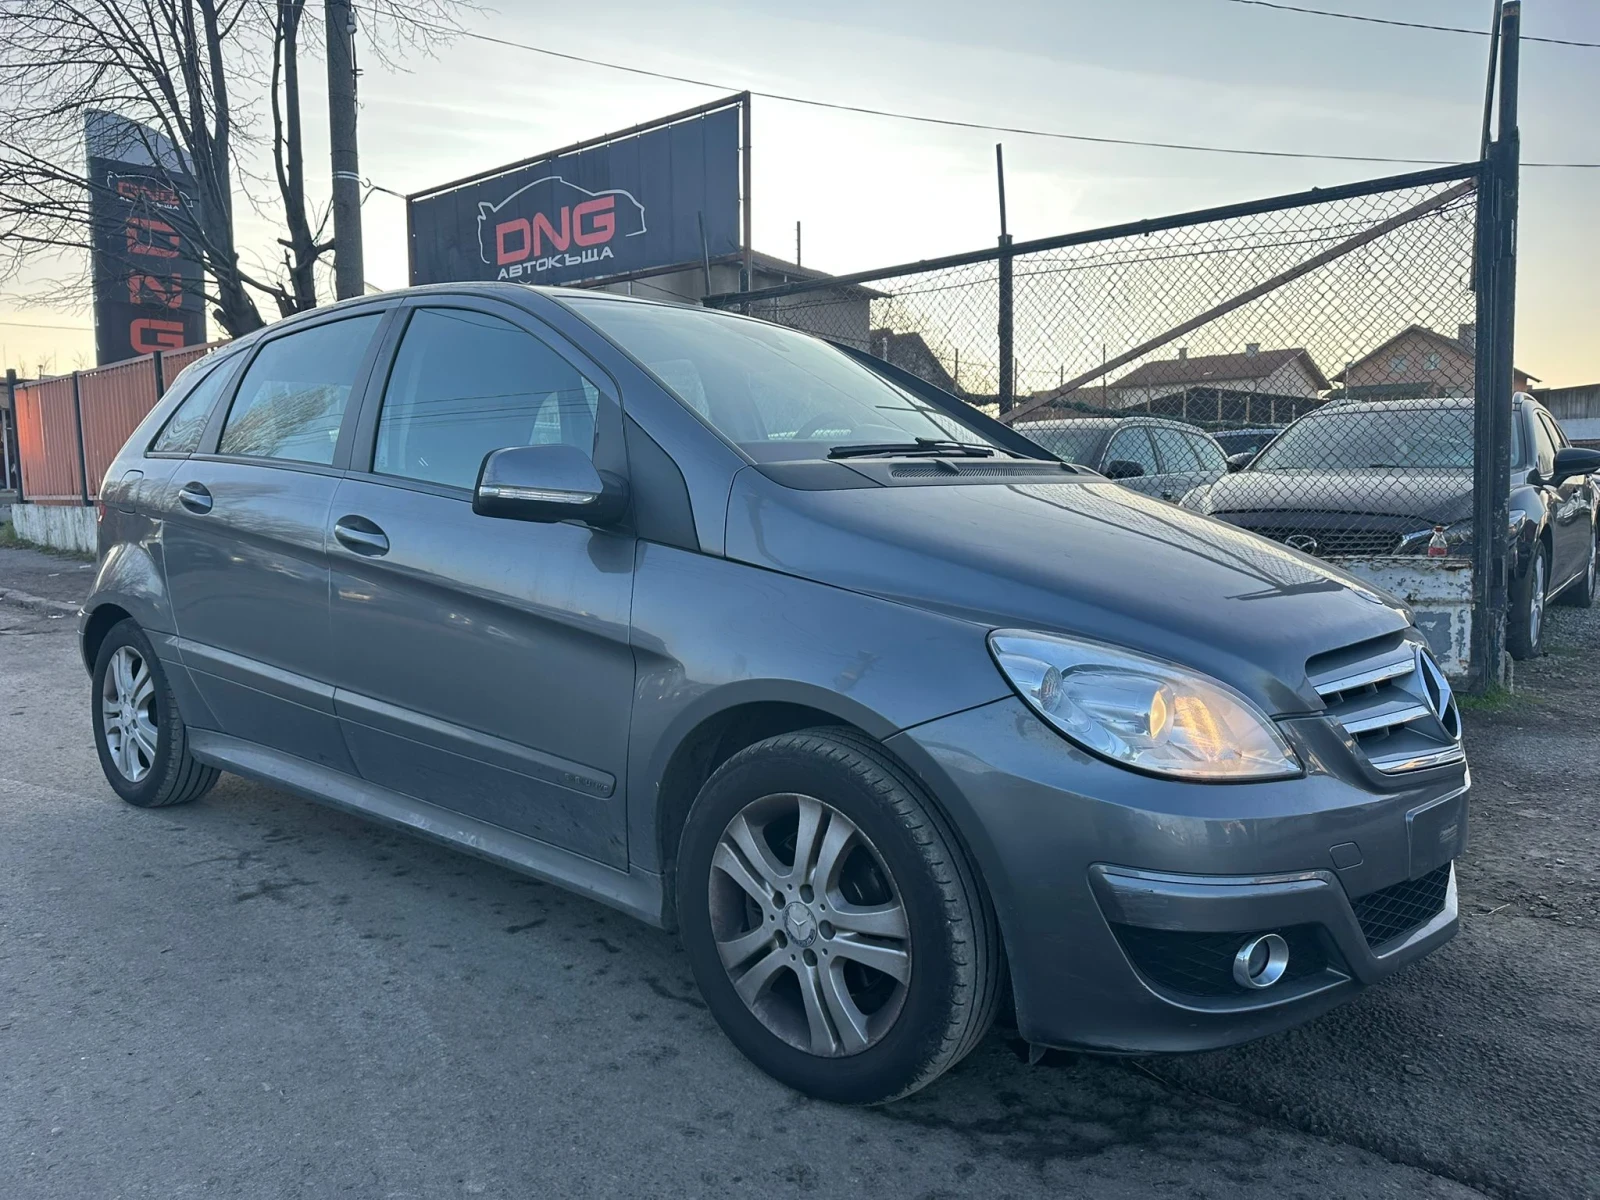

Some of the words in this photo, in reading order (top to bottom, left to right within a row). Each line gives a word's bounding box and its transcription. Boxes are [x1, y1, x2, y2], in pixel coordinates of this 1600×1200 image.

[495, 195, 615, 266] DNG
[497, 246, 615, 281] АВТОКЪЩА
[126, 216, 185, 355] DNG
